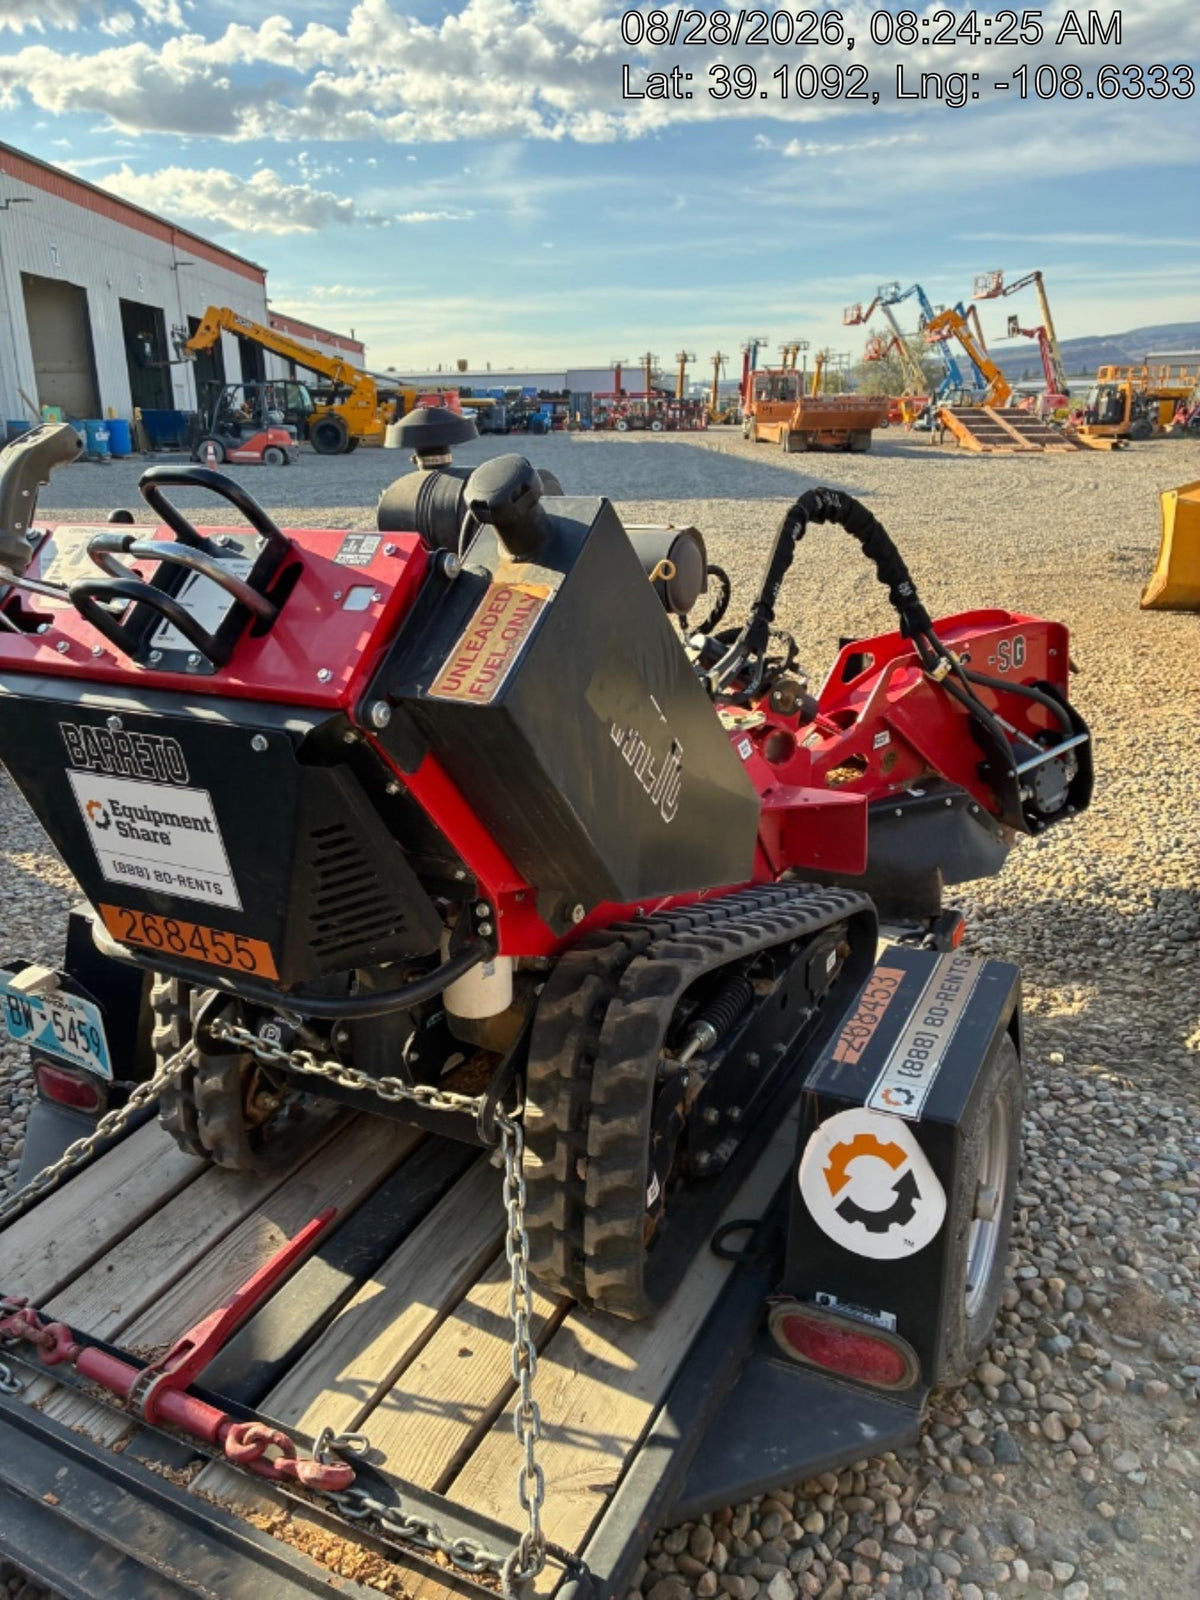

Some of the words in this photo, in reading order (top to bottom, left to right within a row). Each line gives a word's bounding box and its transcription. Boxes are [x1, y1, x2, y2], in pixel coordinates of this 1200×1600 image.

[441, 588, 513, 691] UNLEADED
[468, 645, 512, 695] FUEL
[501, 592, 540, 642] ONLY
[58, 721, 190, 785] BARRETO
[107, 798, 215, 834] Equipment
[115, 820, 172, 846] Share
[112, 859, 150, 881] (888)
[153, 867, 223, 896] 80-RENTS
[118, 908, 257, 972] 268455
[897, 1030, 940, 1078] (888)
[922, 957, 972, 1028] 80-RENTS
